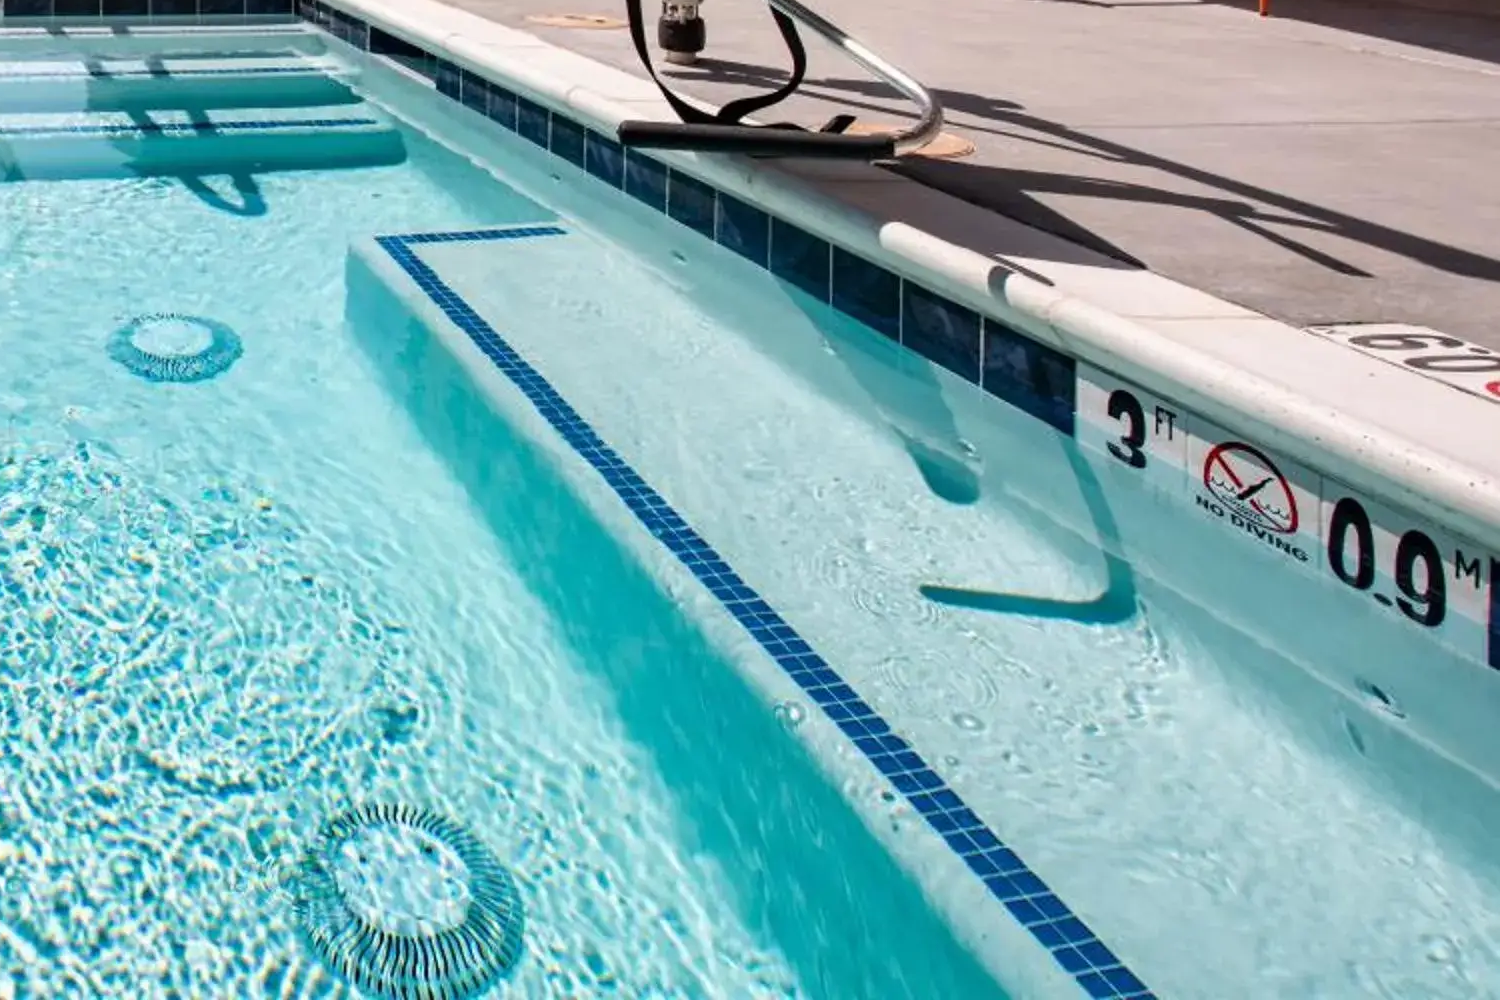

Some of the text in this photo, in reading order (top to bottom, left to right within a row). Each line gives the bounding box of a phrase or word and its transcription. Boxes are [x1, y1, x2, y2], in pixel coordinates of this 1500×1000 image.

[1106, 389, 1178, 469] 3 FT
[1195, 494, 1309, 562] NO DIVING
[1327, 496, 1481, 628] 0.9 M
